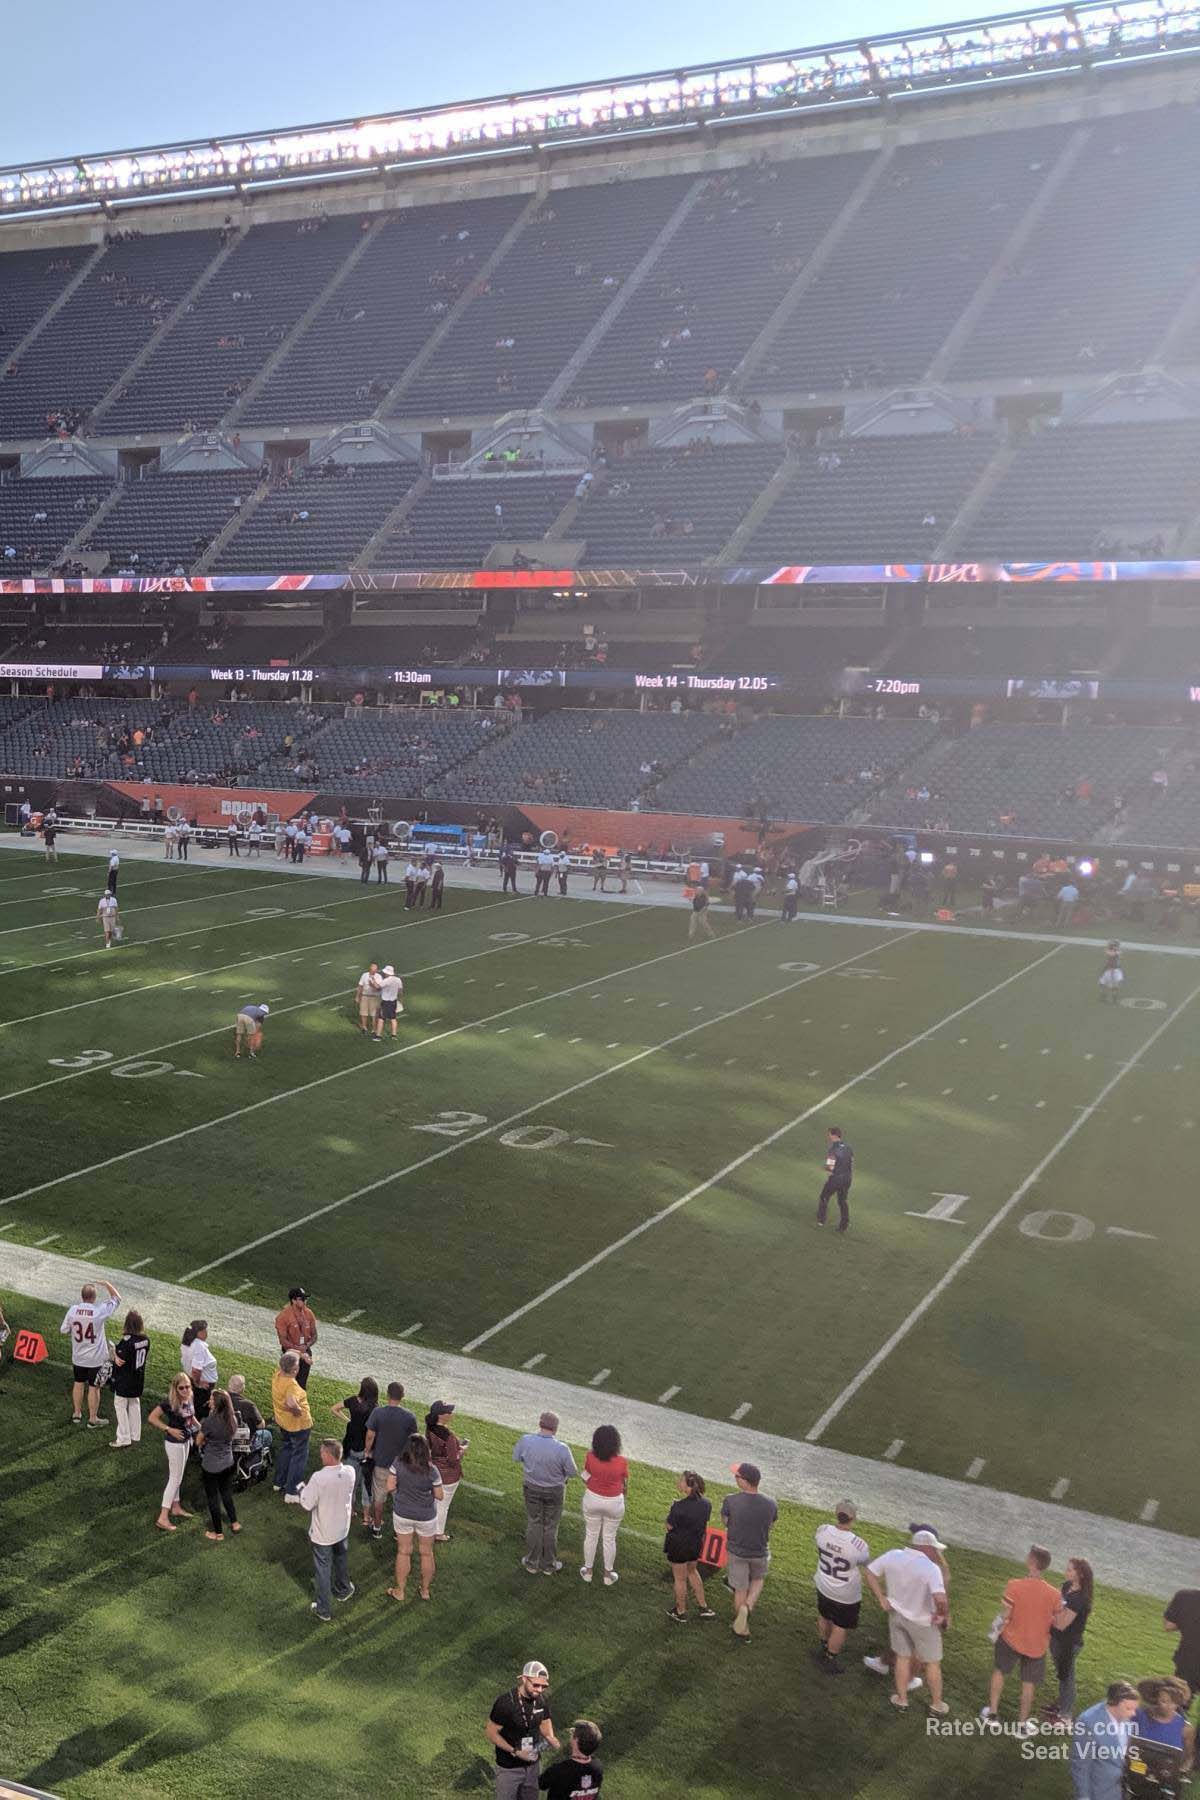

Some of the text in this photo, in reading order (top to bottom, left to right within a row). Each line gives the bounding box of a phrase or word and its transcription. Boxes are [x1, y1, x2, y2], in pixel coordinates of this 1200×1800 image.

[0, 667, 32, 677] Season
[35, 667, 78, 677] Schedule
[211, 670, 234, 681] Week
[235, 670, 244, 681] 13
[252, 670, 289, 683] Thursday
[292, 671, 312, 682] 11.28
[395, 672, 431, 683] 11:30am
[635, 675, 663, 688] Week
[665, 676, 678, 687] 14
[688, 676, 736, 690] Thursday
[739, 677, 767, 689] 12.05
[875, 680, 920, 694] 7:20pm
[47, 1049, 176, 1080] 30
[409, 1110, 571, 1150] 20
[905, 1192, 1096, 1242] 10
[76, 1309, 94, 1317] PAYTON
[73, 1321, 96, 1344] 34
[16, 1335, 38, 1360] 20
[135, 1349, 146, 1369] 10
[706, 1534, 723, 1563] 0
[826, 1542, 842, 1553] MACK
[818, 1549, 850, 1582] 52
